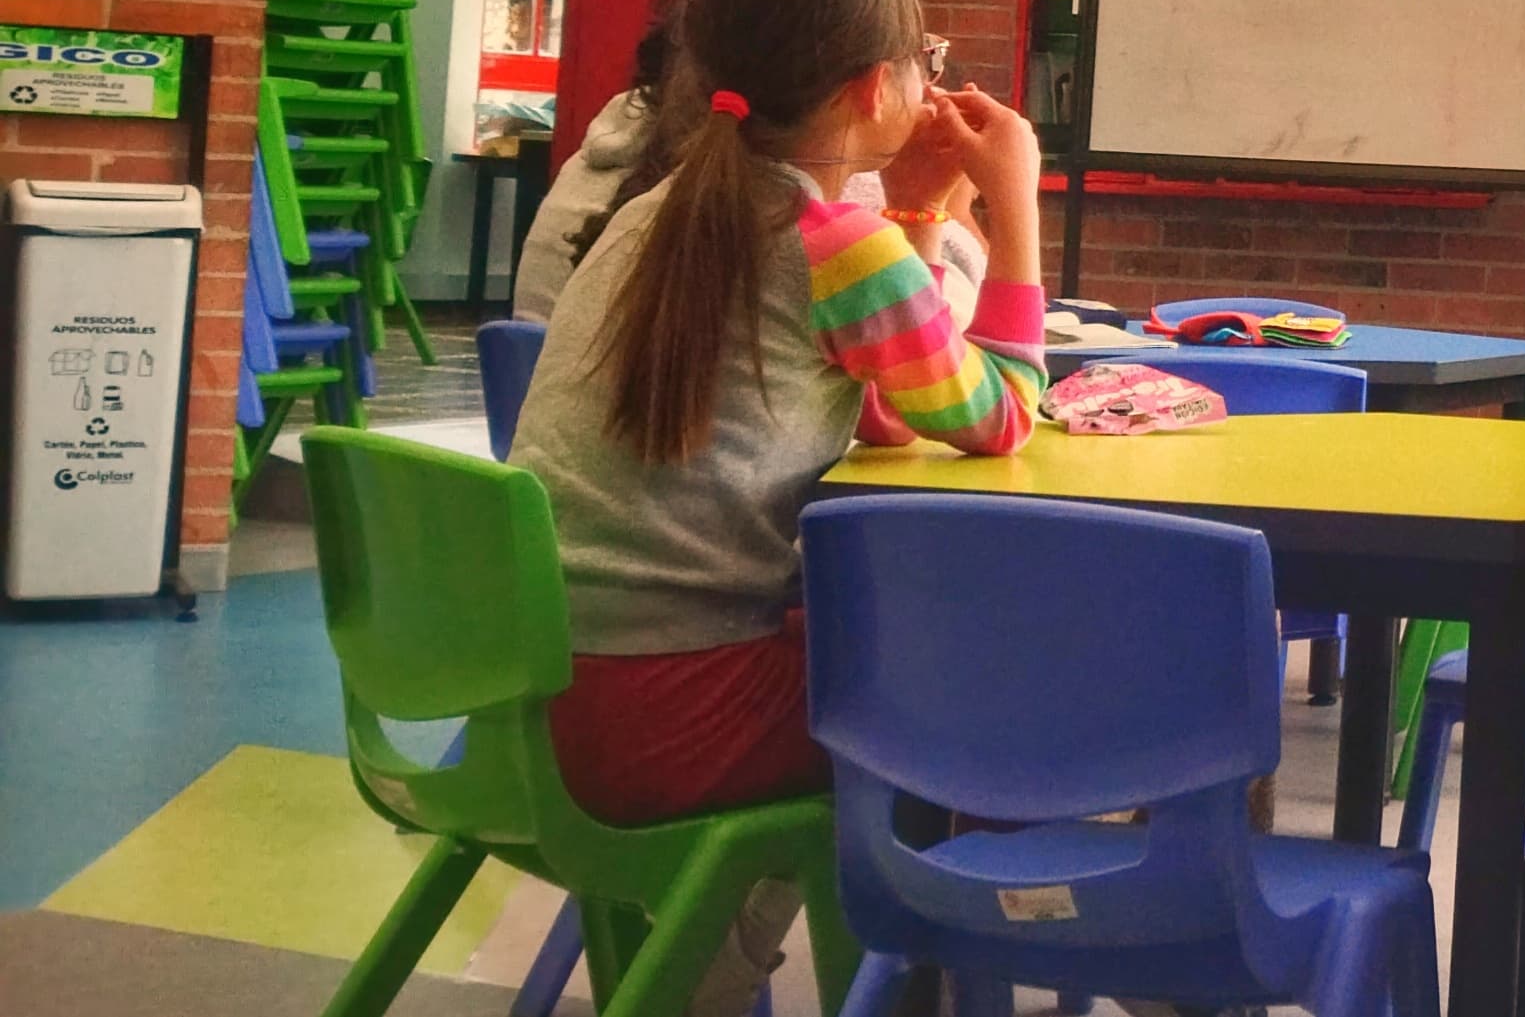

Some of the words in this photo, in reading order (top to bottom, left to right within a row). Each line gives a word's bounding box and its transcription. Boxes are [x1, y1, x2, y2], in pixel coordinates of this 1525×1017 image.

[73, 316, 136, 325] RESIDUOS
[52, 325, 156, 335] APROVECHABLES
[76, 470, 134, 485] Colplast
